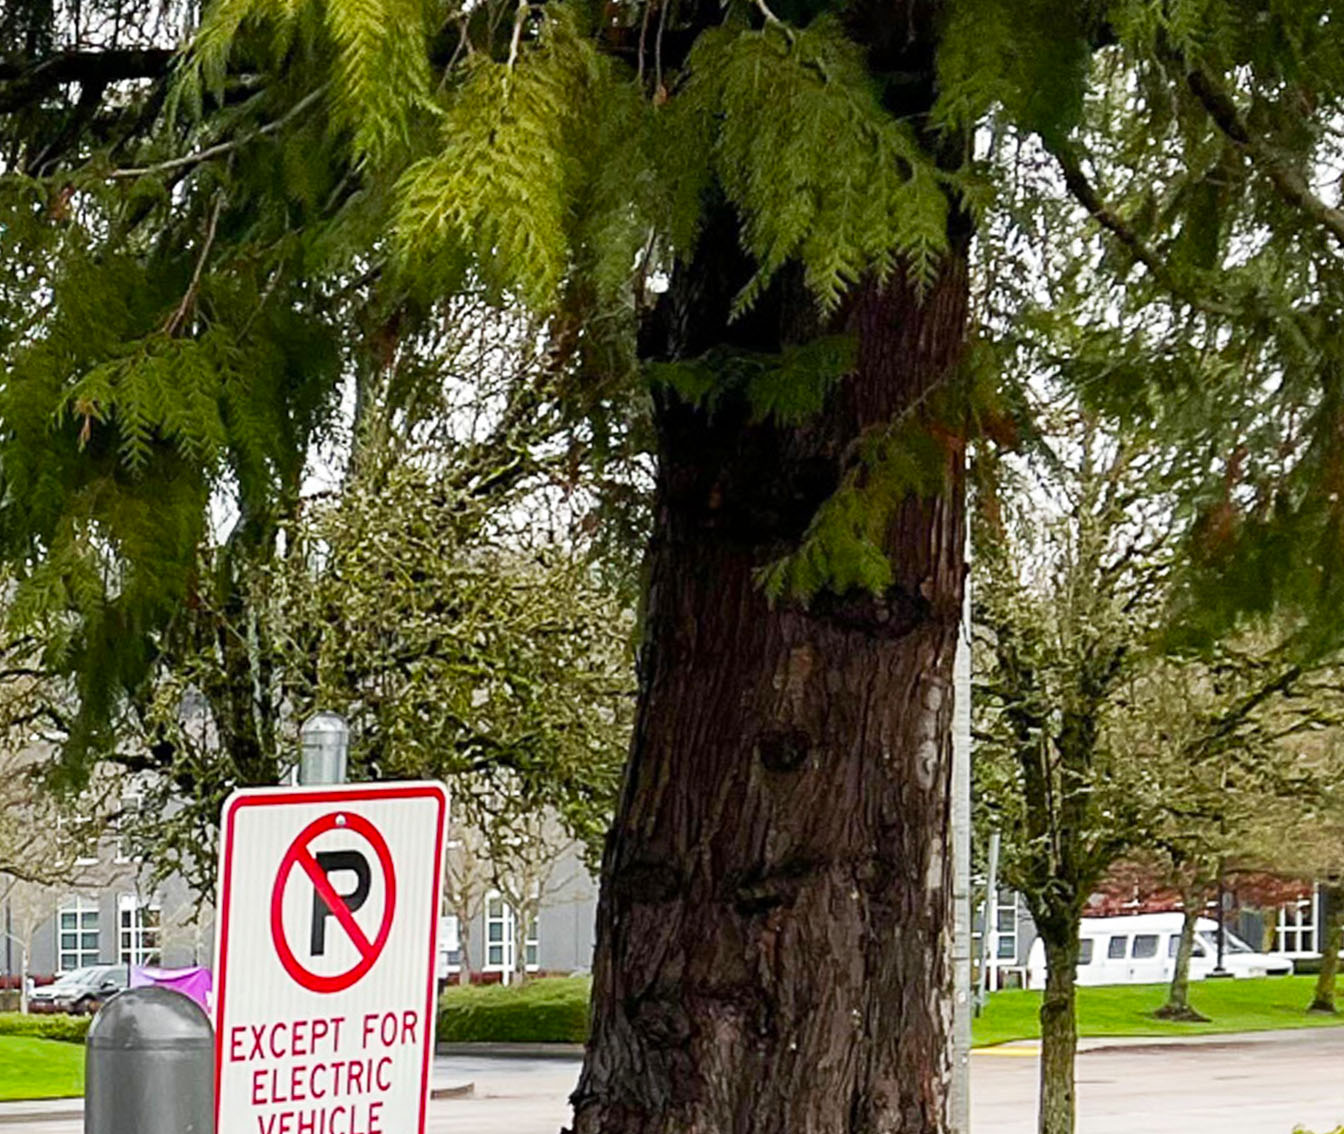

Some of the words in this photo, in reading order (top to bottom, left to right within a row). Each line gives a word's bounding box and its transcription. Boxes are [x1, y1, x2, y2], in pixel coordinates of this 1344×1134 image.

[230, 1016, 346, 1063] EXCEPT
[362, 1010, 418, 1049] FOR
[251, 1056, 393, 1106] ELECTRIC
